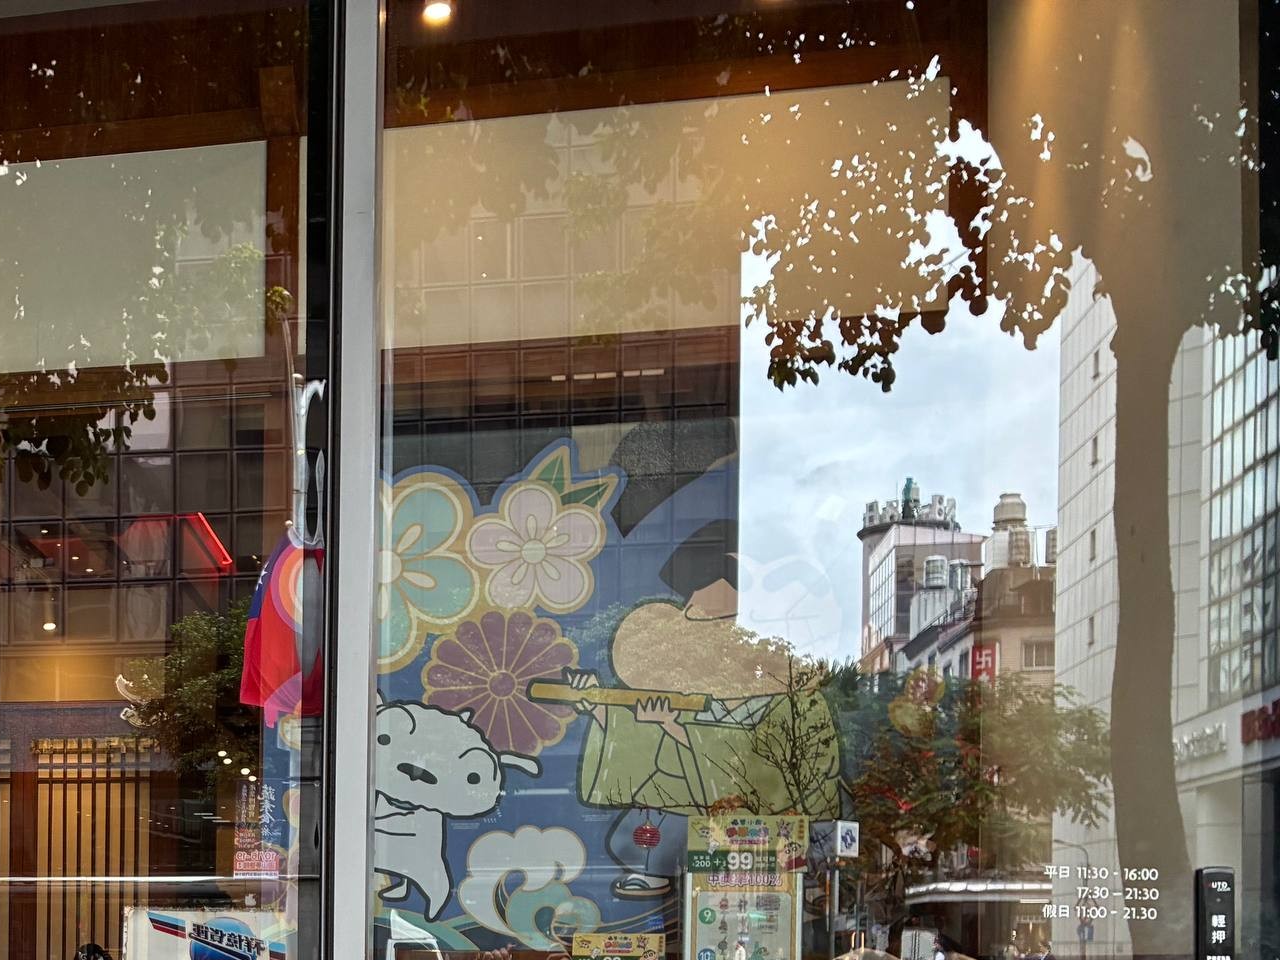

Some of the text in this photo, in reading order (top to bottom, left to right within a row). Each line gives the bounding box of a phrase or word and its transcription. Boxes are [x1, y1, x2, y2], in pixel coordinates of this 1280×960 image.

[1043, 865, 1070, 879] 平日
[1077, 867, 1109, 879] 11:30
[1123, 867, 1159, 881] 16:00
[1077, 886, 1109, 899] 17:30
[1124, 888, 1160, 900] 21:30
[1042, 903, 1070, 919] 假日
[1075, 905, 1108, 919] 11:00
